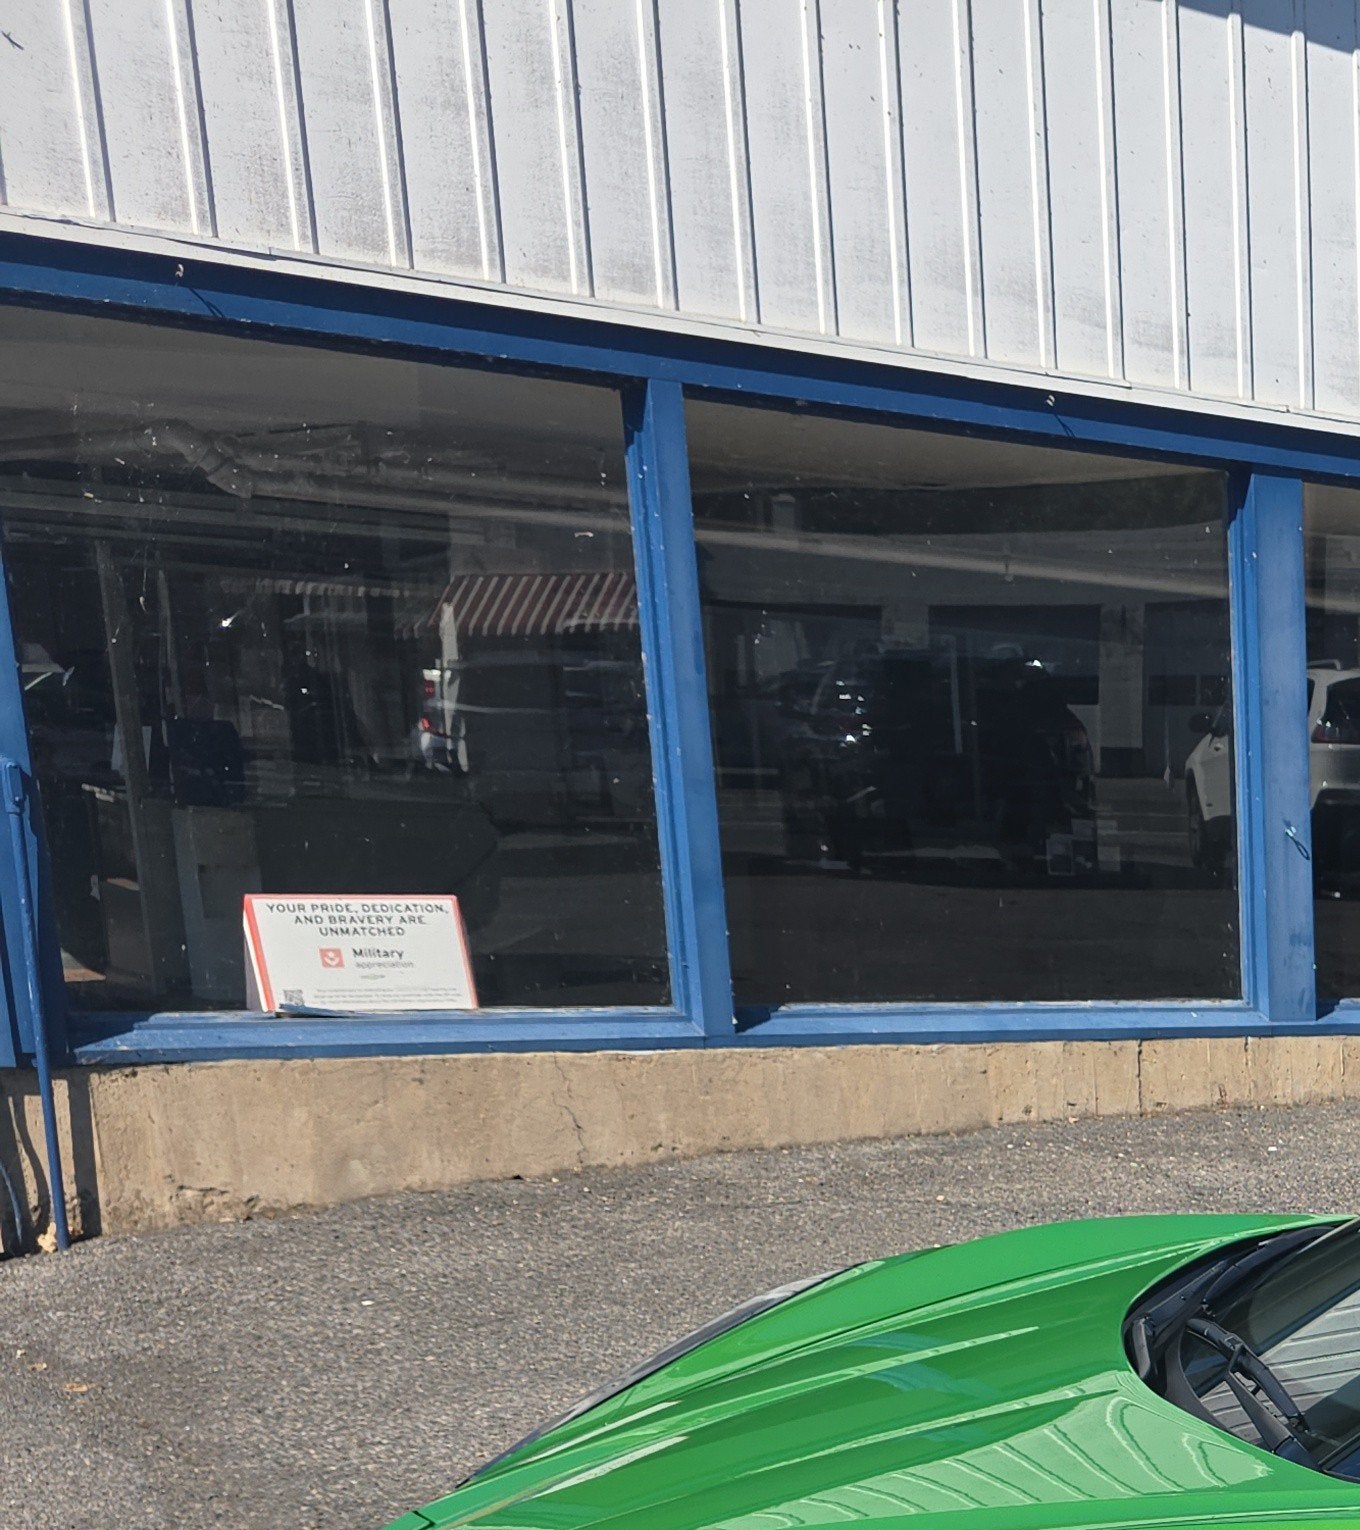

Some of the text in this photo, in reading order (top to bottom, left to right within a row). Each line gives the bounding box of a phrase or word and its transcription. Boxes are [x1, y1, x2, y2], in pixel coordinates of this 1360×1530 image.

[266, 903, 449, 914] YOUR PRIDE, DEDICATION,
[294, 915, 427, 926] AND BRAVERY ARE
[319, 926, 405, 937] UNMATCHED
[352, 948, 404, 960] Military
